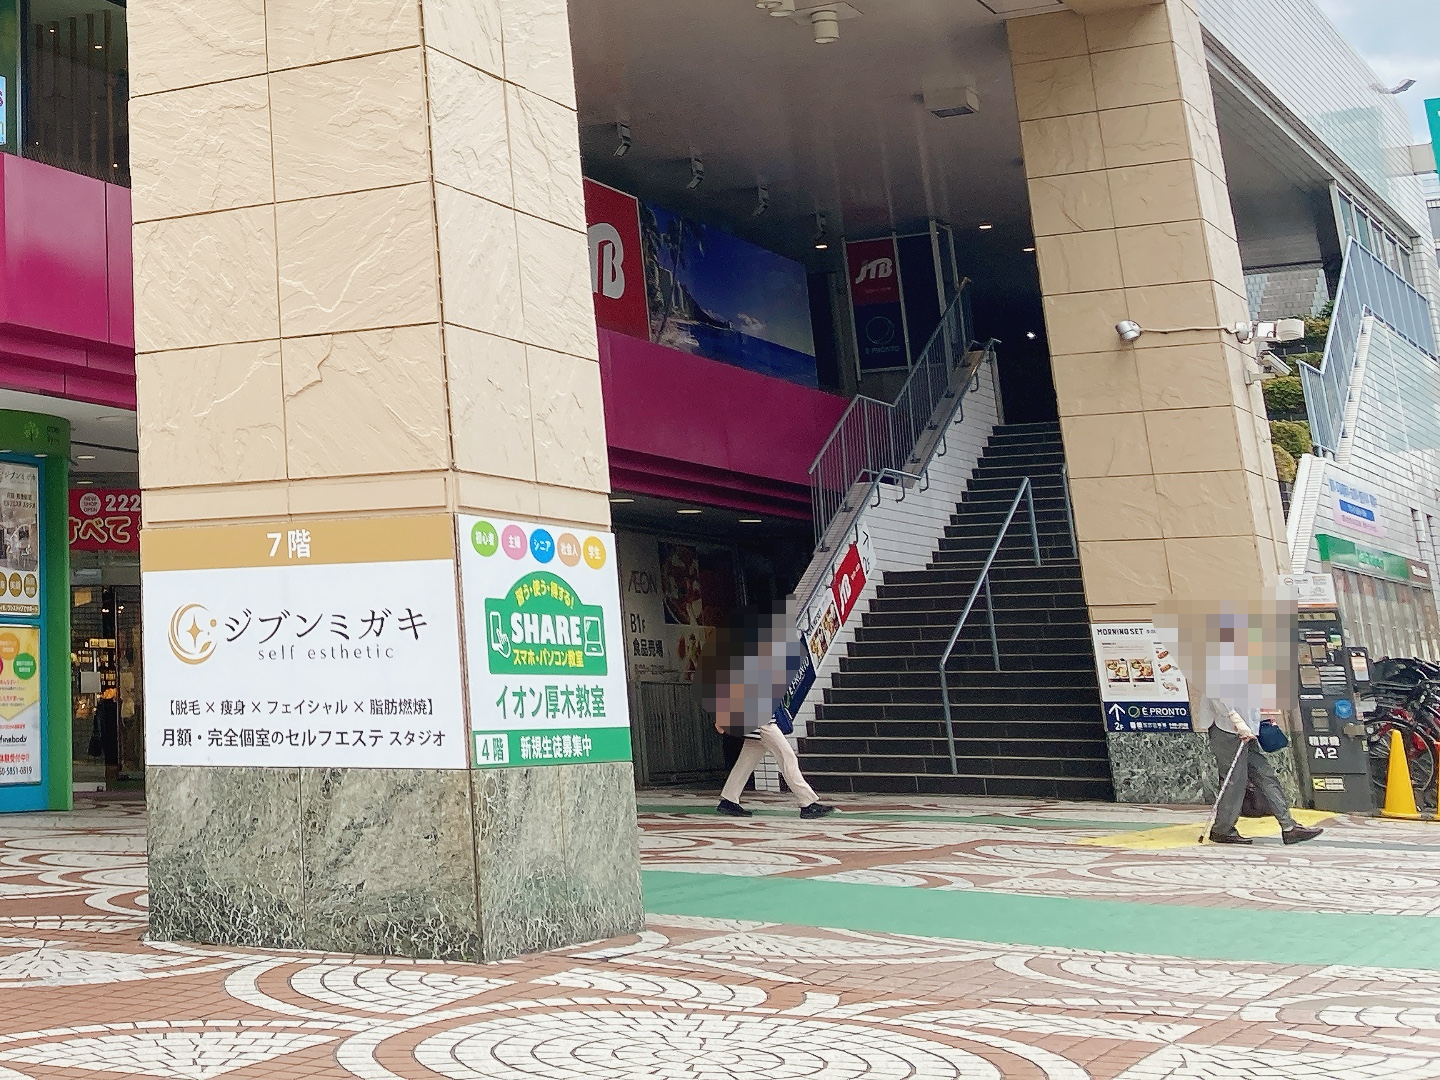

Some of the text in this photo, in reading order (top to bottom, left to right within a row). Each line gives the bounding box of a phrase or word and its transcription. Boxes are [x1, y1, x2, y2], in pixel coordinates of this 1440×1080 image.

[855, 258, 892, 284] JTB
[105, 494, 141, 512] 222
[267, 529, 311, 559] 7階
[534, 539, 550, 552] シニア
[587, 545, 601, 560] 学生
[225, 608, 427, 644] ジブンミガキ
[510, 612, 582, 645] SHARE
[258, 644, 394, 660] self esthetic
[513, 648, 584, 668] スマホ・パソコン教室
[496, 684, 606, 719] イオン厚木教室
[1149, 707, 1187, 716] PRONTO
[482, 734, 592, 761] 4階 新規生徒募集中
